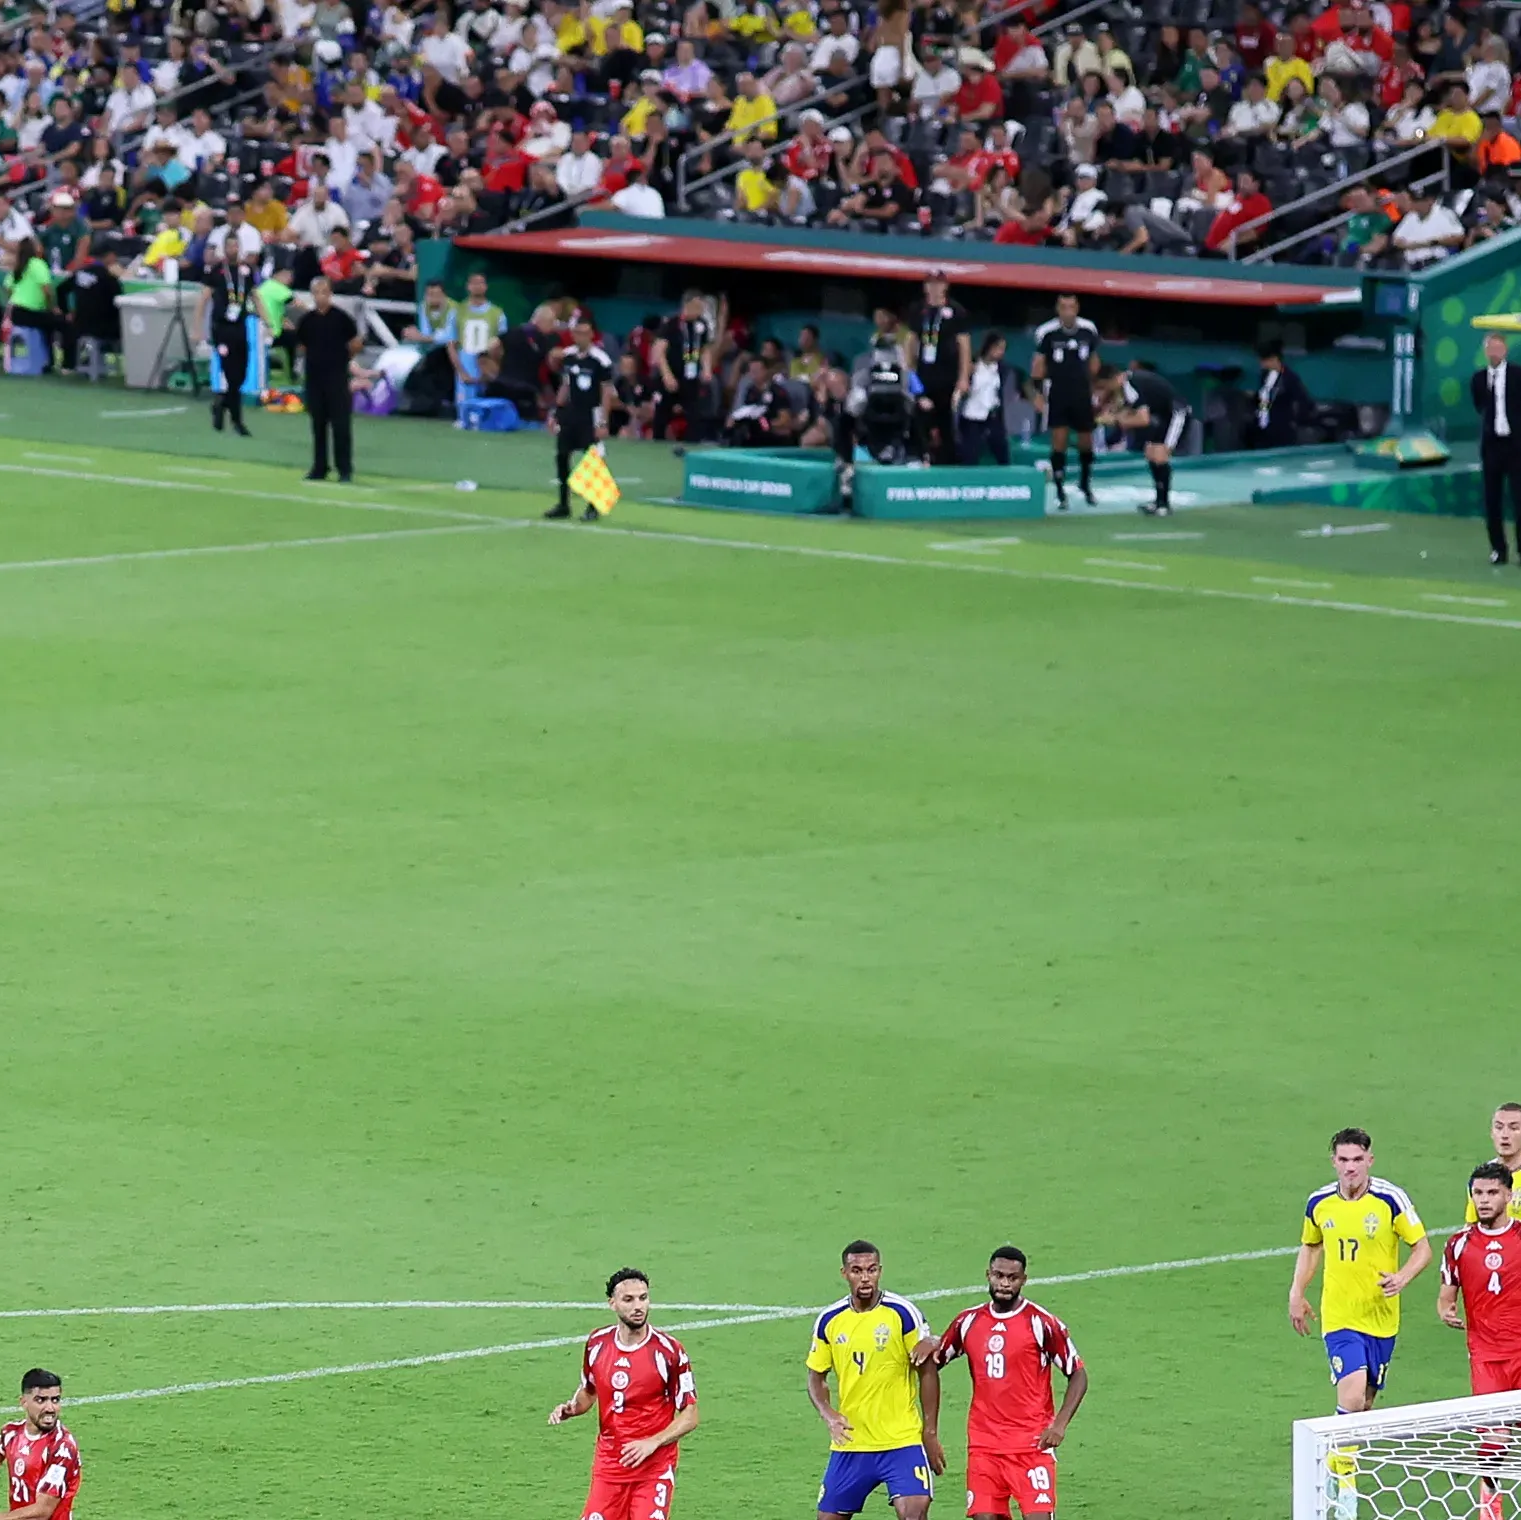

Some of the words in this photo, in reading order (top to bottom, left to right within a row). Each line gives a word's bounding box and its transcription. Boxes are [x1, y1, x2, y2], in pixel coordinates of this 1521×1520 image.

[711, 476, 742, 492] WORLD
[743, 479, 760, 493] CUP
[886, 487, 915, 501] FIFA
[915, 487, 960, 501] WORLD
[961, 486, 987, 501] CUP
[1339, 1239, 1359, 1262] 17
[1488, 1272, 1502, 1296] 4
[854, 1352, 865, 1376] 4
[986, 1353, 1005, 1379] 19
[9, 1477, 27, 1503] 21
[915, 1467, 929, 1490] 4
[1027, 1467, 1050, 1491] 19
[654, 1483, 668, 1508] 3
